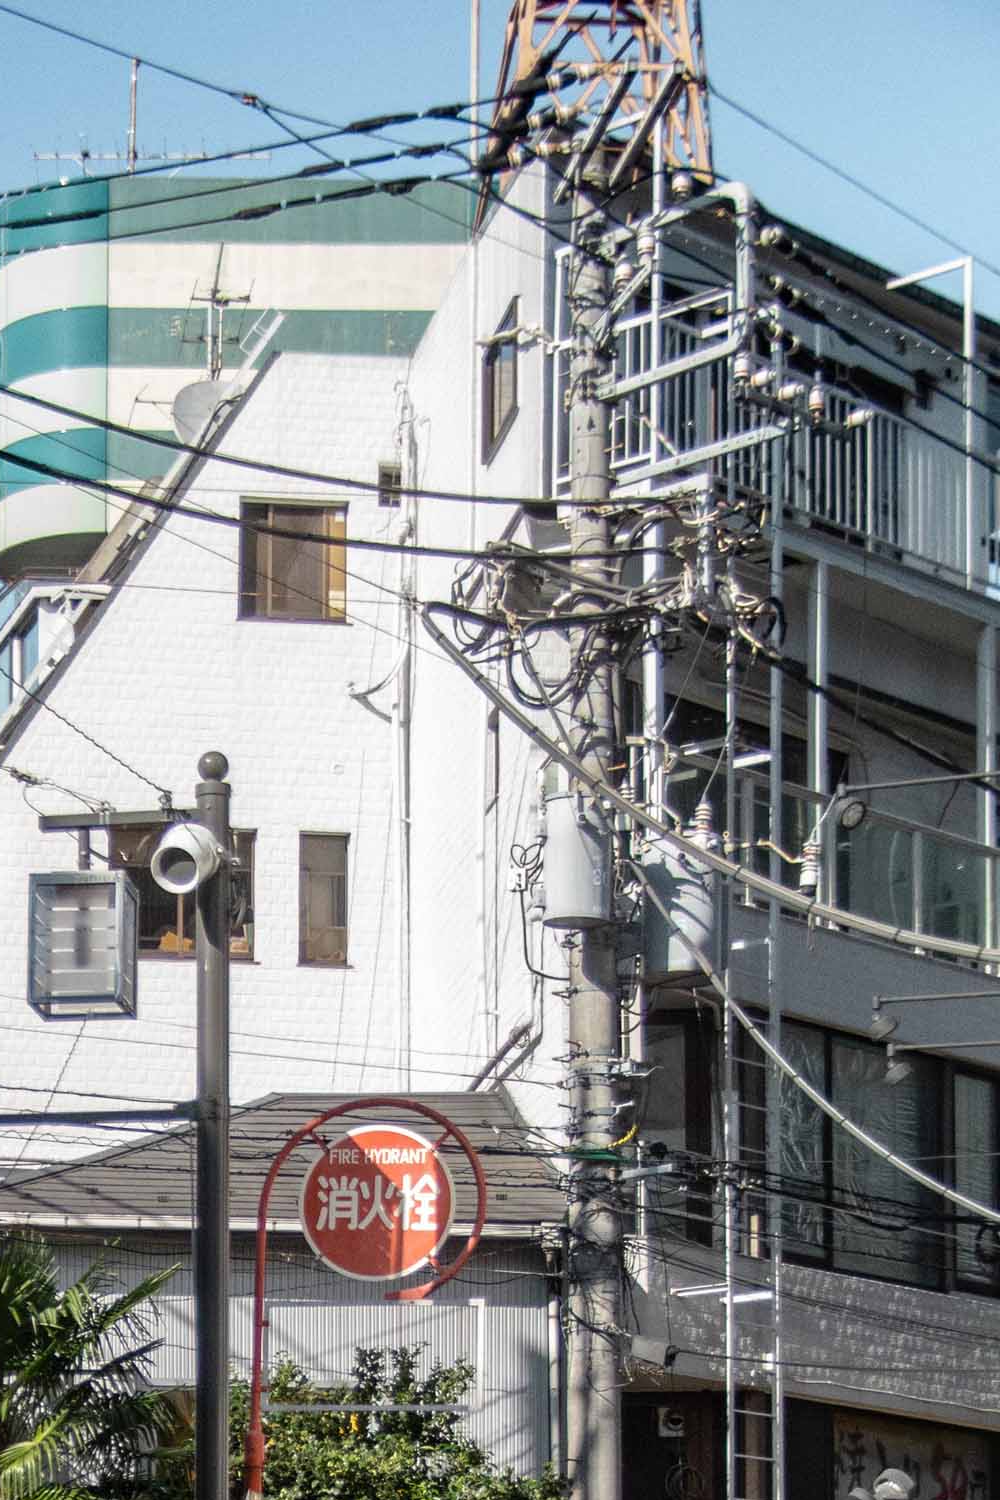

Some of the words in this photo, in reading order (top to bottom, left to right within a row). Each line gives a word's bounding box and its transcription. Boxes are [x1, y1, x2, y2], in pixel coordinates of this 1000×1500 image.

[329, 1148, 360, 1165] FIRE
[364, 1147, 427, 1165] HYDRANT
[315, 1173, 440, 1232] 消火栓
